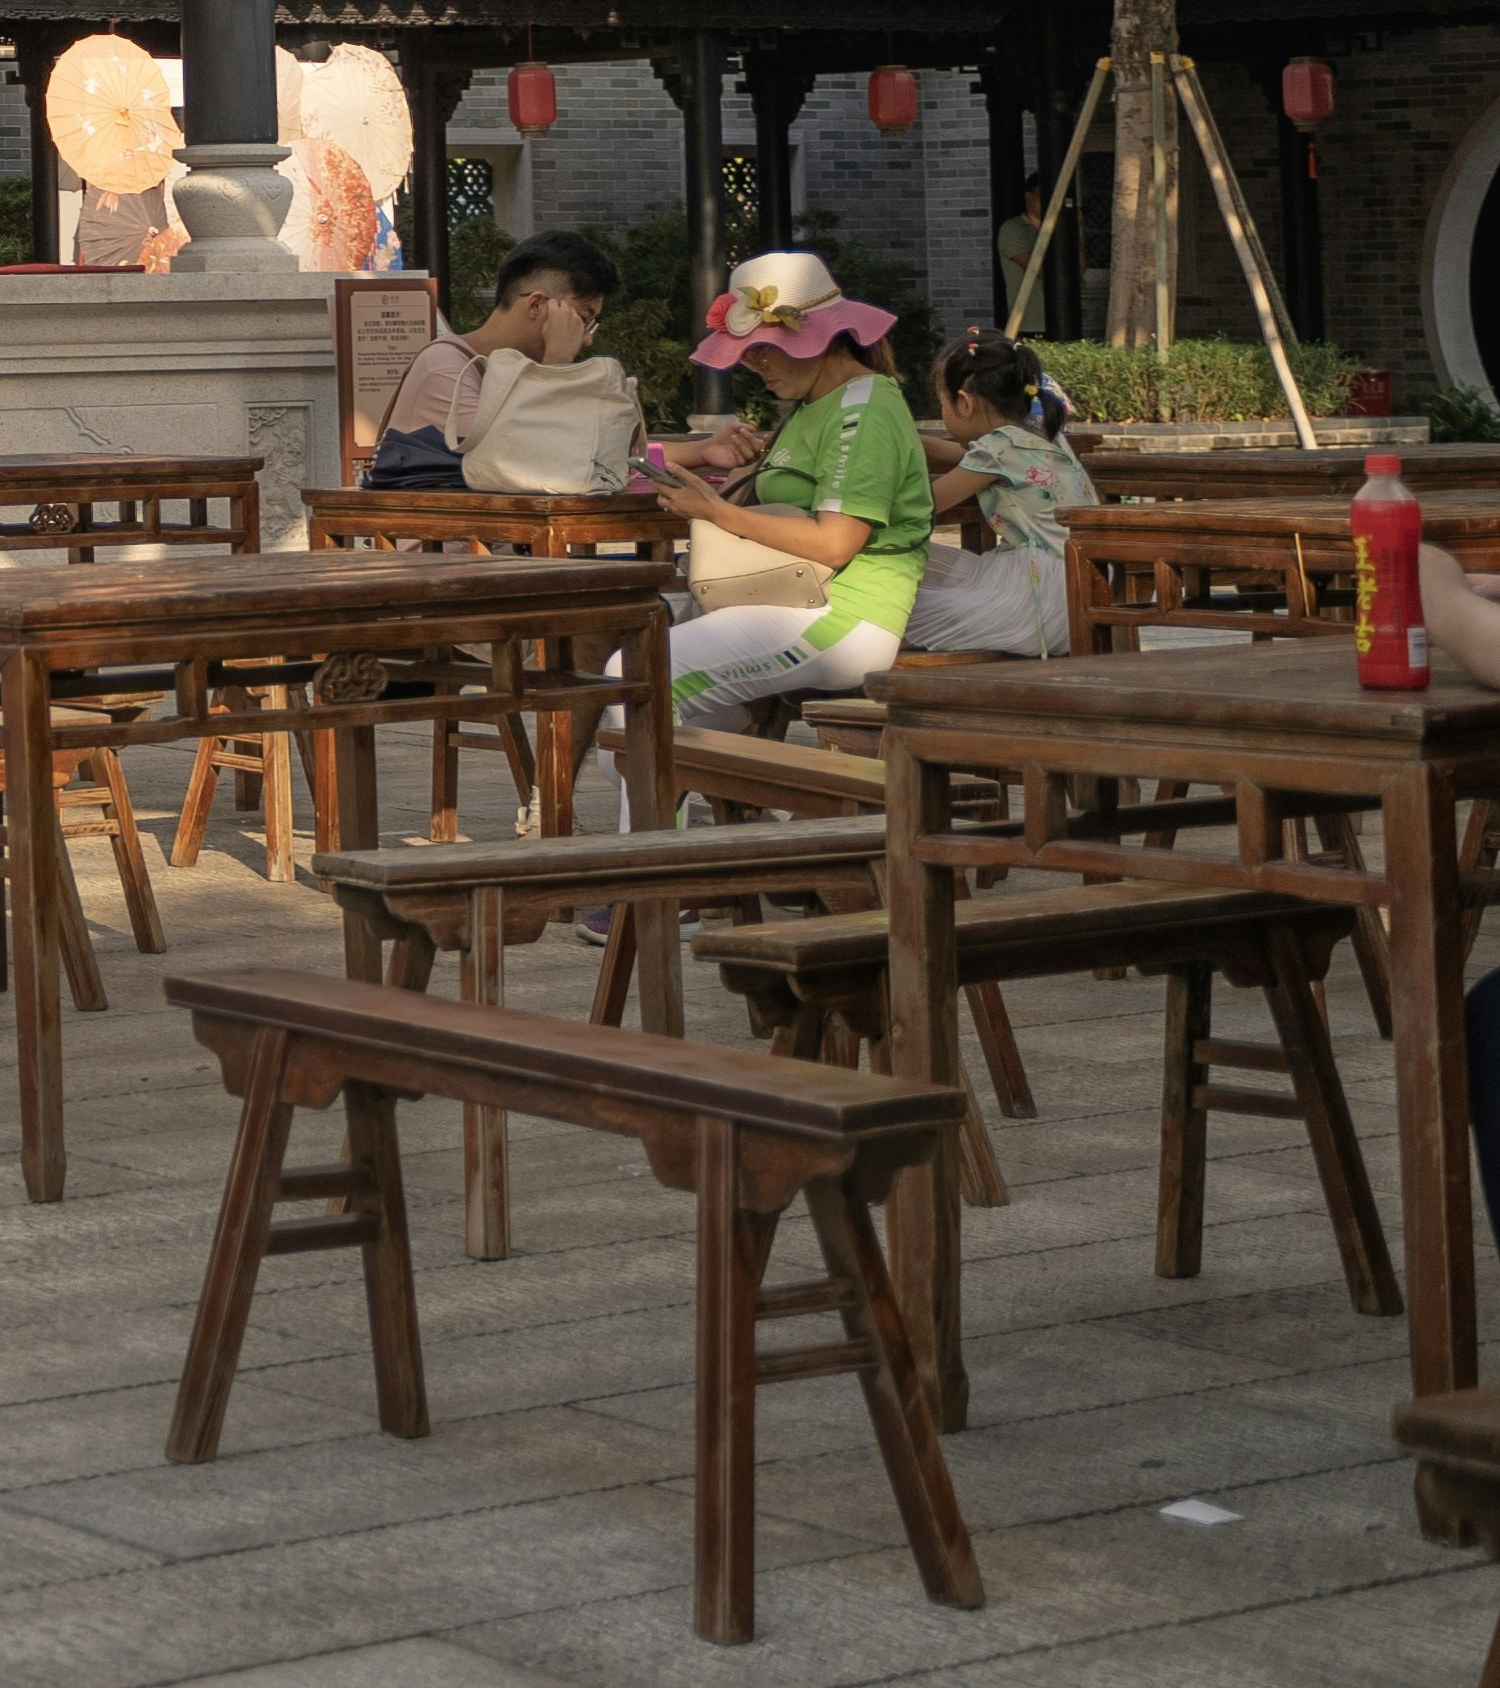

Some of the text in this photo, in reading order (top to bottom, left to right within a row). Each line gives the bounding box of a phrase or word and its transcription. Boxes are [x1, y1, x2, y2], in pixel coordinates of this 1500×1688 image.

[832, 444, 850, 489] smile
[1354, 535, 1378, 654] 王老吉
[720, 660, 772, 681] smile
